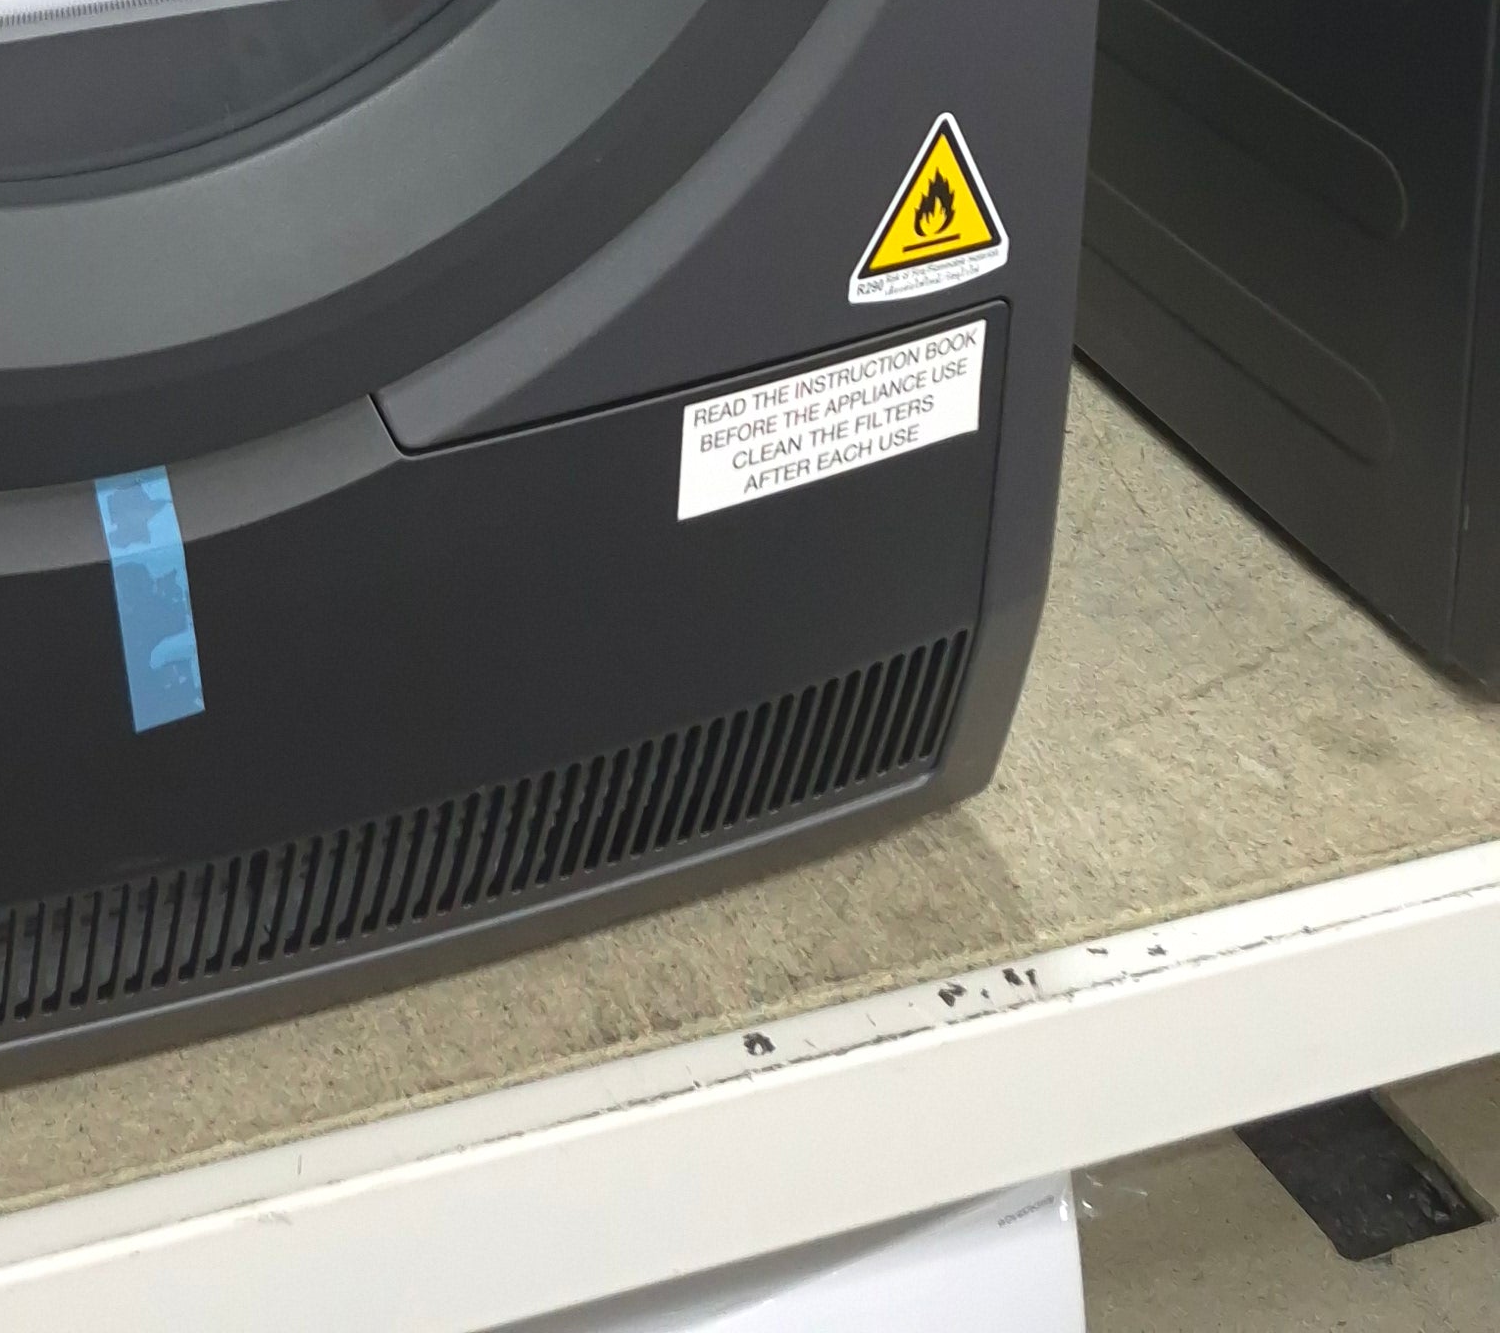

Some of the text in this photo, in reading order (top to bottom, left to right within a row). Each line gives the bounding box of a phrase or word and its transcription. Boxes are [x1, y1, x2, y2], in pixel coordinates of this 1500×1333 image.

[693, 326, 980, 429] READ THE INSTRUCTION BOOK
[699, 357, 969, 454] BEFORE THE APPLIANCE USE
[731, 394, 936, 470] CLEAN THE FILTERS
[743, 424, 920, 494] AFTER EACH USE
